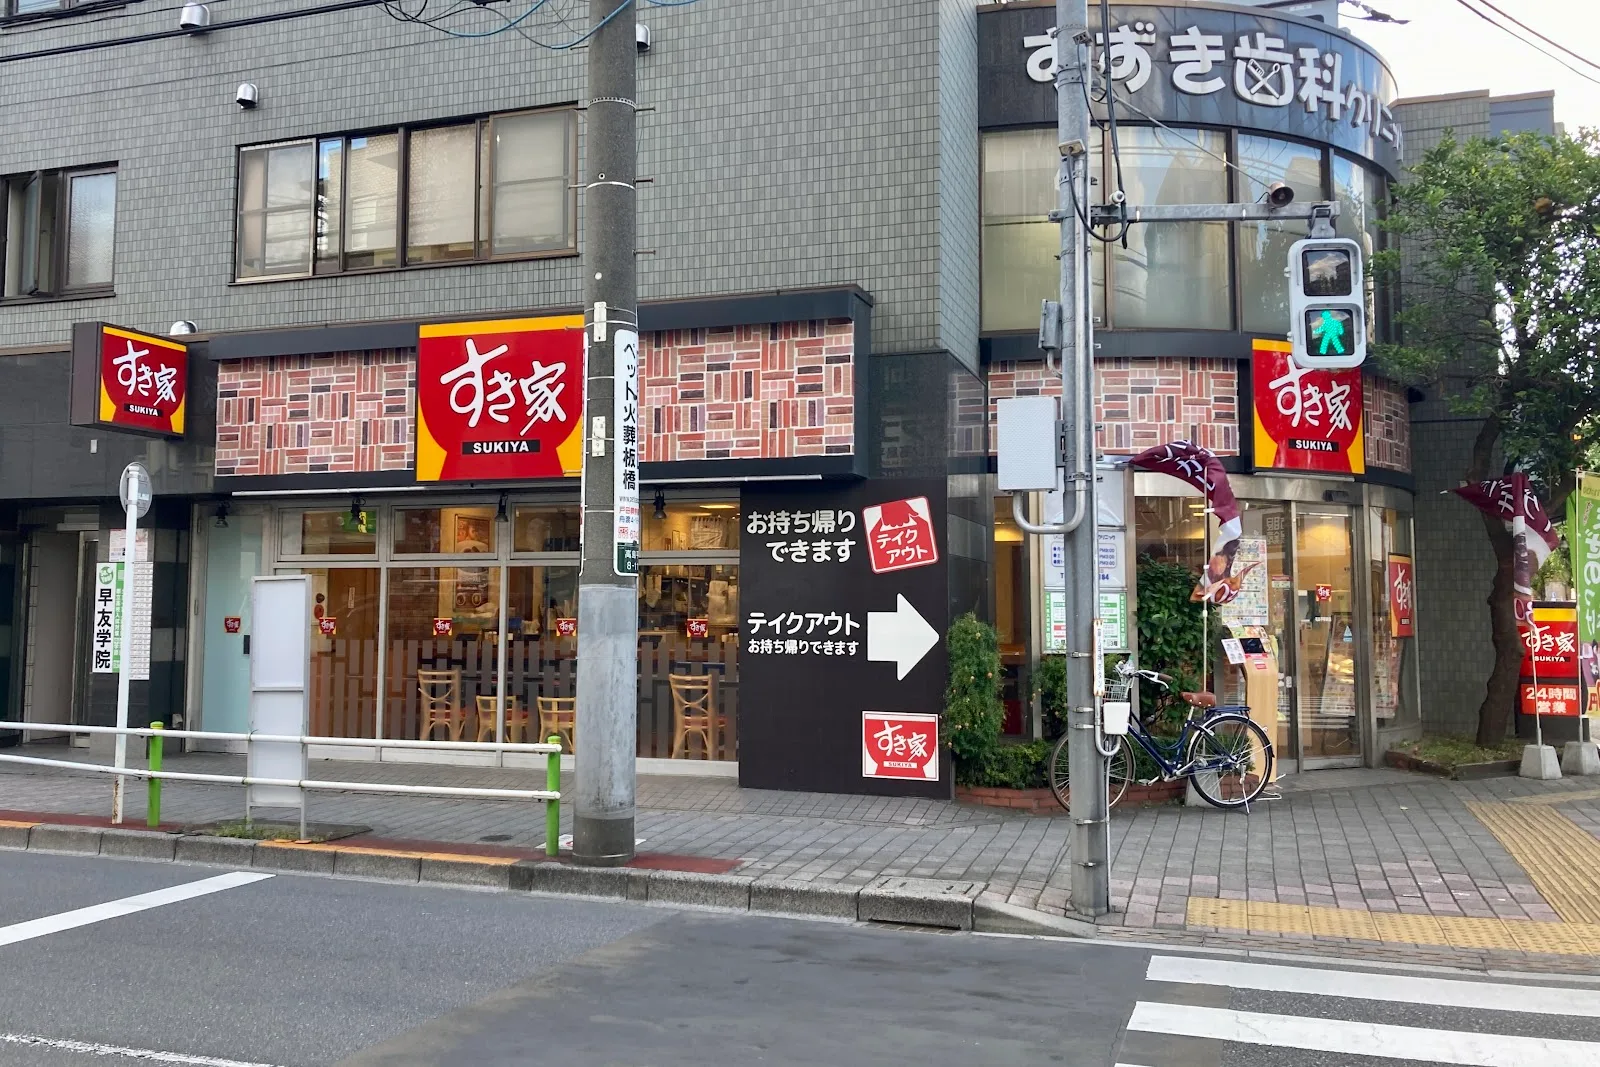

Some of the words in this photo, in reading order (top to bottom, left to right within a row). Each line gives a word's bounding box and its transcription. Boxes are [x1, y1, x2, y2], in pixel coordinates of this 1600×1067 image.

[112, 340, 177, 407] すき家
[440, 338, 567, 437] すき家
[1268, 355, 1352, 438] すき家
[129, 404, 159, 417] SUKIYA
[622, 343, 637, 490] ペット火葬板橋
[473, 441, 529, 454] SUKIYA
[1295, 439, 1333, 451] SUKIYA
[746, 509, 856, 535] お持ち帰り
[765, 538, 857, 563] できます
[876, 529, 918, 550] テイク
[886, 544, 928, 565] アウト
[95, 588, 113, 669] 早友学院
[747, 611, 860, 636] テイクアウト
[748, 639, 860, 656] お持ち帰りできます
[1521, 626, 1575, 656] すき家
[1525, 687, 1577, 701] 24時間
[1537, 700, 1567, 714] 営業
[873, 720, 928, 761] すき家
[888, 760, 913, 768] SUKIYA
